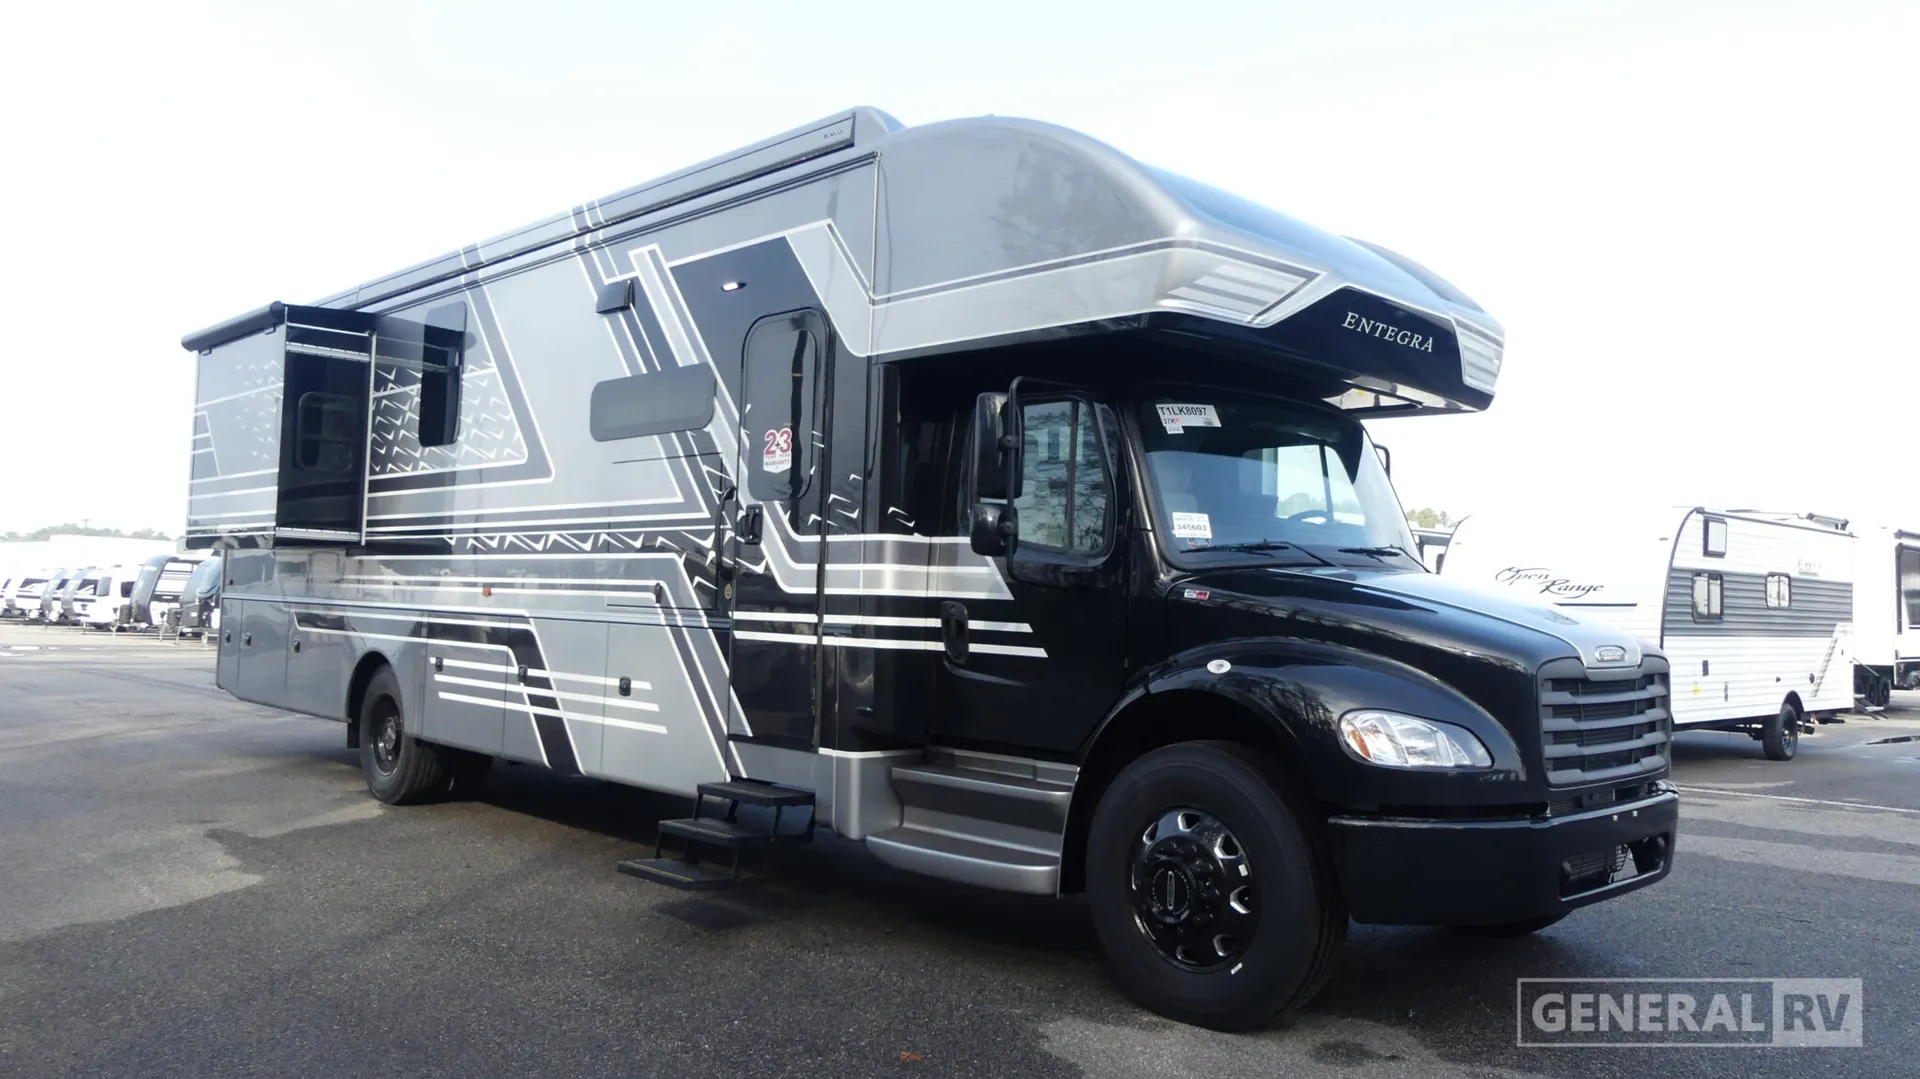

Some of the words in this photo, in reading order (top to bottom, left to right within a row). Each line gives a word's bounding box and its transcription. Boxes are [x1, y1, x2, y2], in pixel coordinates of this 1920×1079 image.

[1342, 311, 1433, 353] ENTEGRA
[1158, 406, 1207, 416] T1LK8097
[764, 459, 790, 467] WARRANTY
[1495, 566, 1551, 586] Open
[1538, 578, 1604, 599] Range
